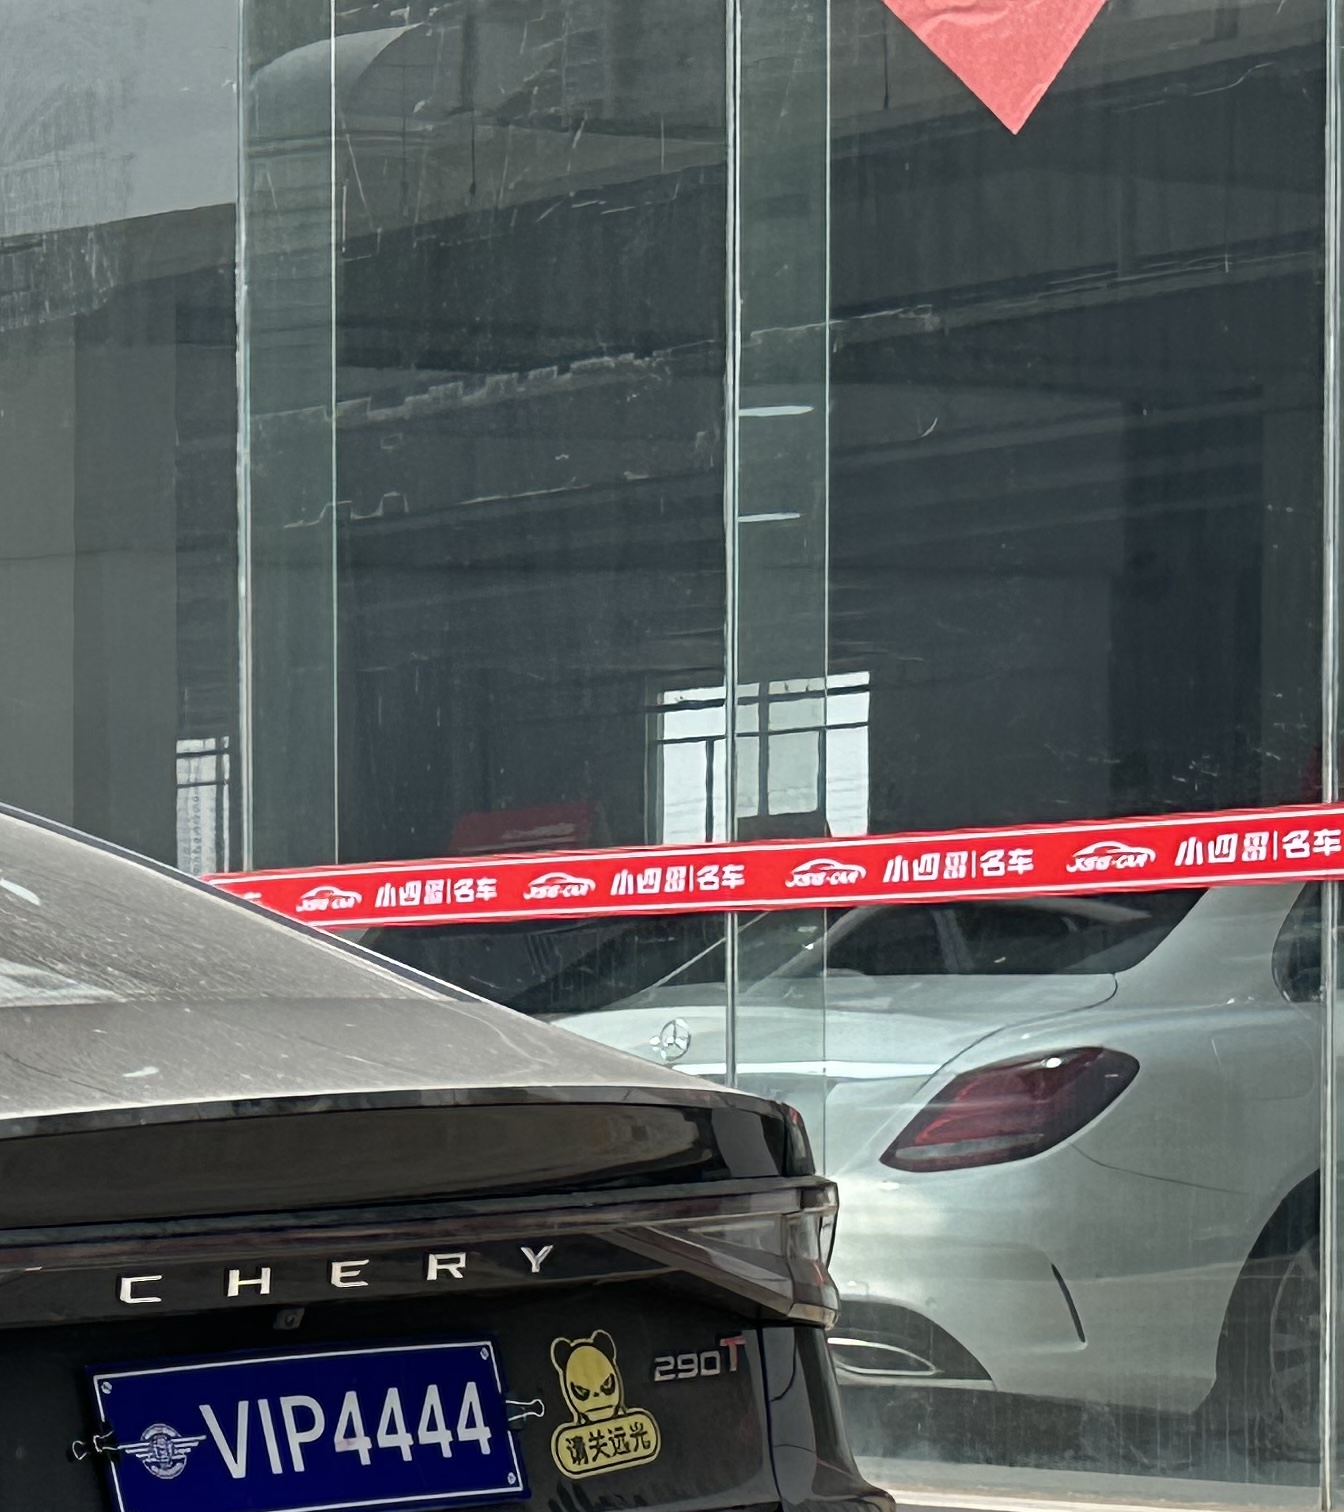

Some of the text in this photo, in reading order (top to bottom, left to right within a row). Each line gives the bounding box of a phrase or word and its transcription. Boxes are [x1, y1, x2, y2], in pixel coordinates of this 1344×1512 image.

[118, 1244, 555, 1304] CHERY
[653, 1335, 747, 1382] 290T
[198, 1381, 492, 1479] VIP4444
